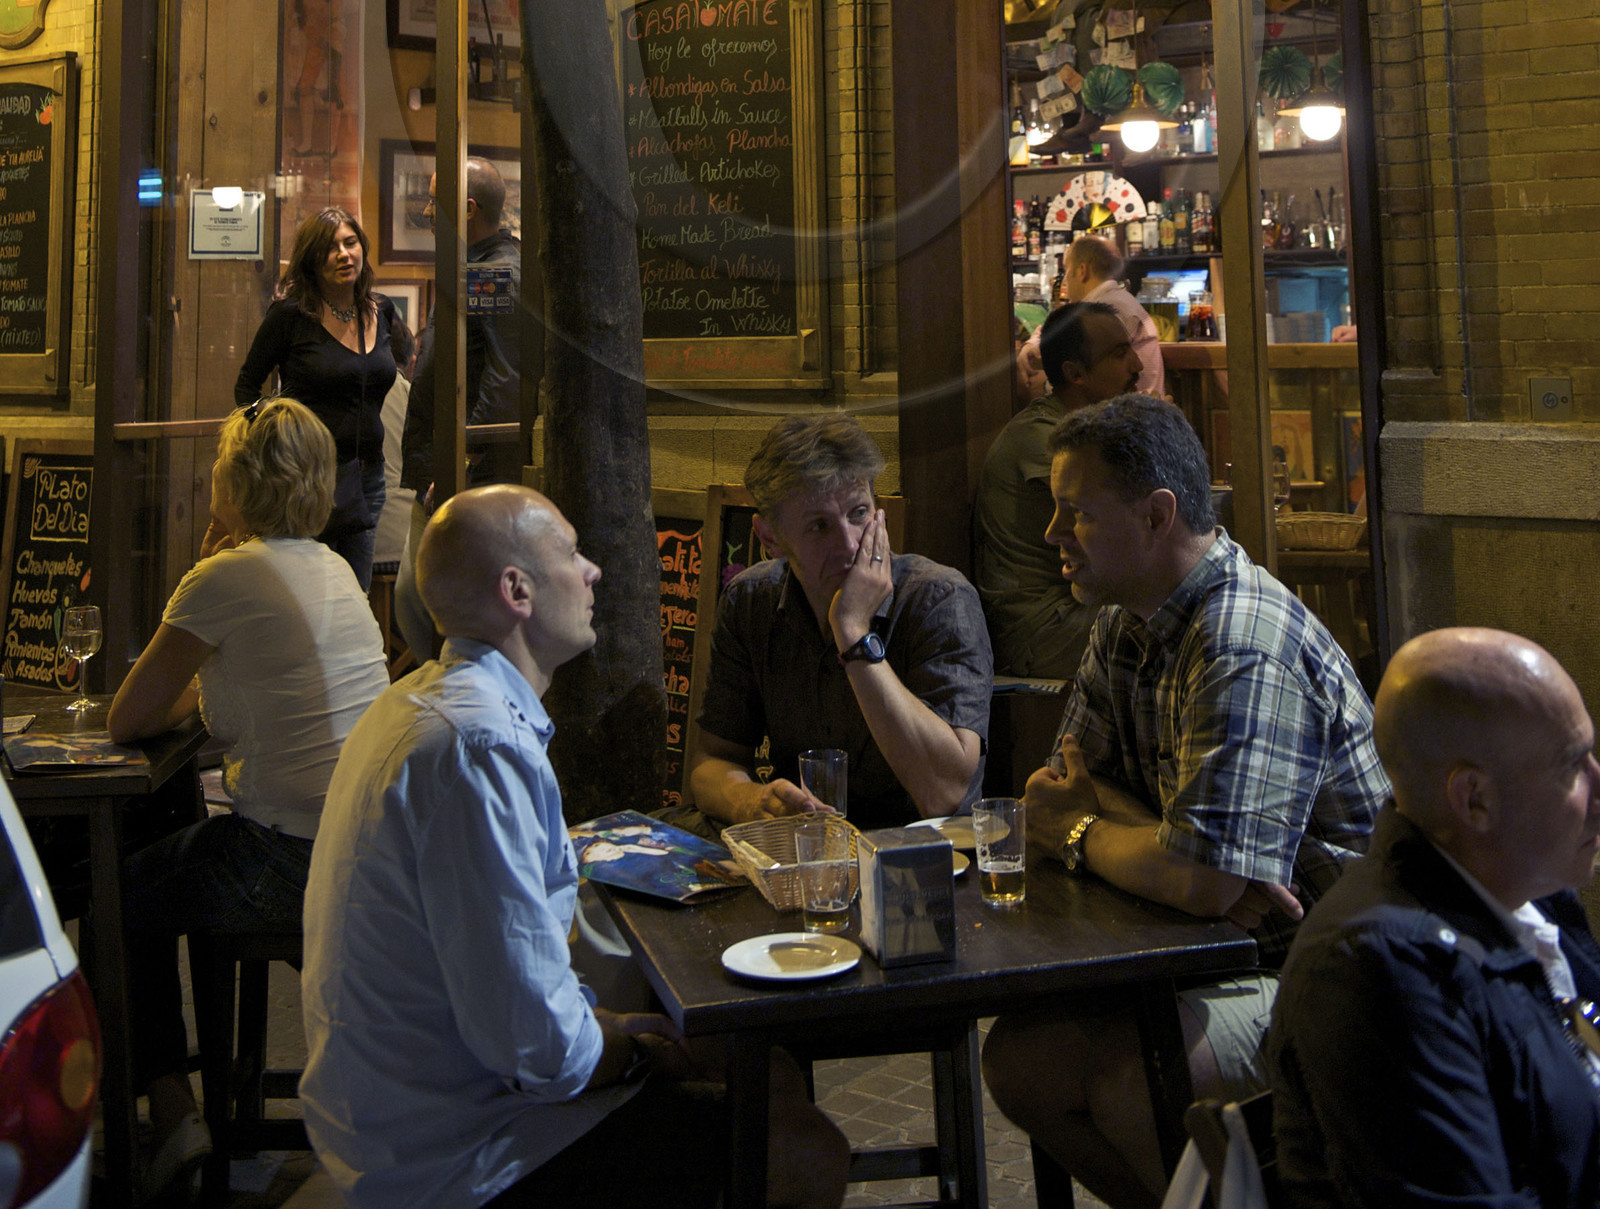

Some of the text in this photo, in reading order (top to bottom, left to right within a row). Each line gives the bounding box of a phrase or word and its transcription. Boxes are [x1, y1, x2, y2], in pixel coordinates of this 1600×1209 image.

[648, 43, 672, 73] Hoy
[676, 36, 691, 59] le
[720, 78, 738, 94] en
[743, 70, 791, 96] Salsa
[639, 100, 787, 131] Meatballs in Sauce
[727, 126, 792, 154] Plancha
[638, 161, 694, 187] Grilled
[673, 196, 699, 217] del
[641, 213, 774, 250] Home Made Bread
[639, 259, 698, 284] Tortilla
[701, 254, 720, 280] al
[1, 296, 26, 312] TOMATO
[695, 285, 769, 311] Omelette
[700, 317, 722, 336] In
[34, 500, 61, 533] Del
[12, 580, 57, 605] Huevos
[14, 659, 55, 683] Asados
